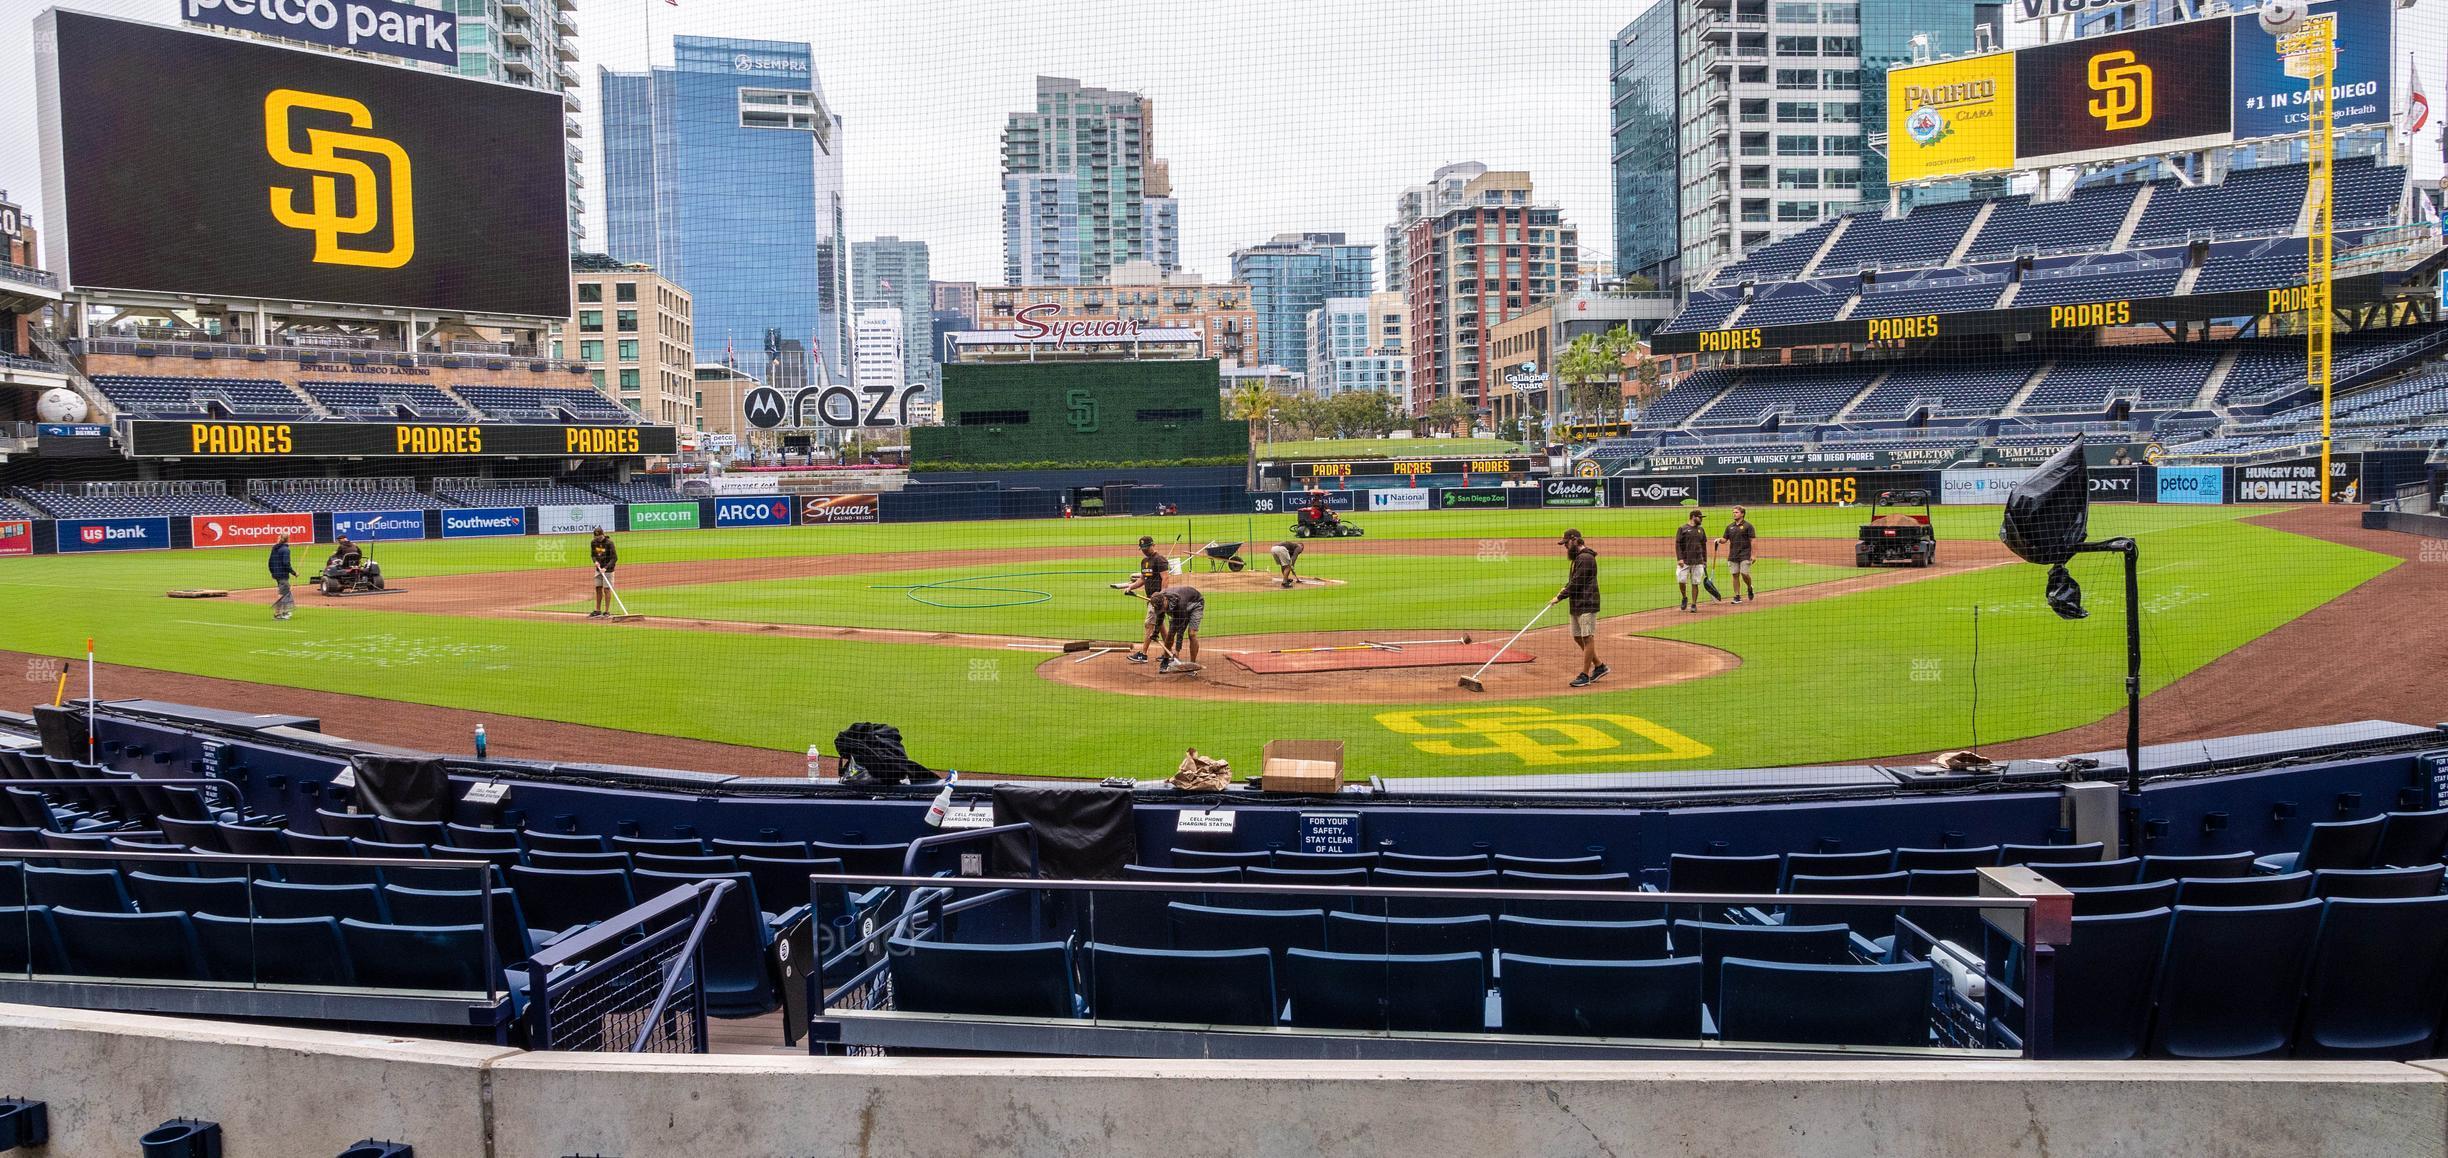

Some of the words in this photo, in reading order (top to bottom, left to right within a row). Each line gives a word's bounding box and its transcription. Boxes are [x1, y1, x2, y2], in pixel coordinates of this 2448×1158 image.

[347, 3, 453, 53] park
[754, 58, 807, 72] SEMPRA
[2088, 49, 2153, 131] SD
[2246, 96, 2265, 109] #1
[2271, 93, 2288, 108] IN
[2293, 89, 2325, 105] SAN
[2331, 80, 2377, 100] DIEGO
[1956, 108, 1994, 121] CLARA
[2285, 113, 2300, 124] UC
[2346, 104, 2376, 117] Health
[264, 88, 415, 269] SD
[2051, 301, 2130, 329] PADRES
[1014, 302, 1143, 349] Sycuan
[1868, 314, 1939, 341] PADRES
[1699, 328, 1761, 352] PADRES
[351, 366, 387, 375] JALISCO
[390, 367, 430, 376] LANDING
[1505, 373, 1550, 383] Gallagher
[1511, 382, 1543, 391] Square
[792, 383, 926, 428] razr
[191, 424, 292, 453] PADRES
[396, 426, 482, 454] PADRES
[566, 428, 639, 453] PADRES
[1649, 456, 1704, 466] TEMPLETON
[1718, 455, 1752, 465] OFFICIAL
[1753, 454, 1788, 463] WHISKEY
[1807, 453, 1823, 462] SAN
[1823, 452, 1845, 462] DIEGO
[1846, 452, 1875, 462] PADRES
[1889, 449, 1954, 460] TEMPLETON
[1471, 460, 1510, 472] PADRES
[2245, 467, 2291, 479] HUNGRY
[2293, 466, 2316, 478] FOR
[2329, 462, 2347, 477] 322
[1547, 480, 1592, 495] Chosen
[1772, 477, 1856, 504] PADRES
[1944, 478, 1972, 491] blue
[1989, 477, 2017, 491] blue
[2087, 478, 2132, 491] ONY
[2160, 475, 2198, 494] petco
[2240, 481, 2321, 500] HOMERS
[1390, 493, 1425, 501] National
[1471, 495, 1491, 503] Diego
[1631, 484, 1690, 500] EVOTEK
[718, 503, 770, 520] ARCO
[806, 498, 870, 522] Sycuan
[1255, 499, 1274, 511] 396
[447, 516, 511, 530] Southwest
[228, 524, 306, 538] Snapdragon
[1326, 817, 1348, 826] YOUR
[1312, 827, 1345, 836] SAFETY,
[1305, 836, 1325, 844] STAY
[1327, 836, 1353, 844] CLEAR
